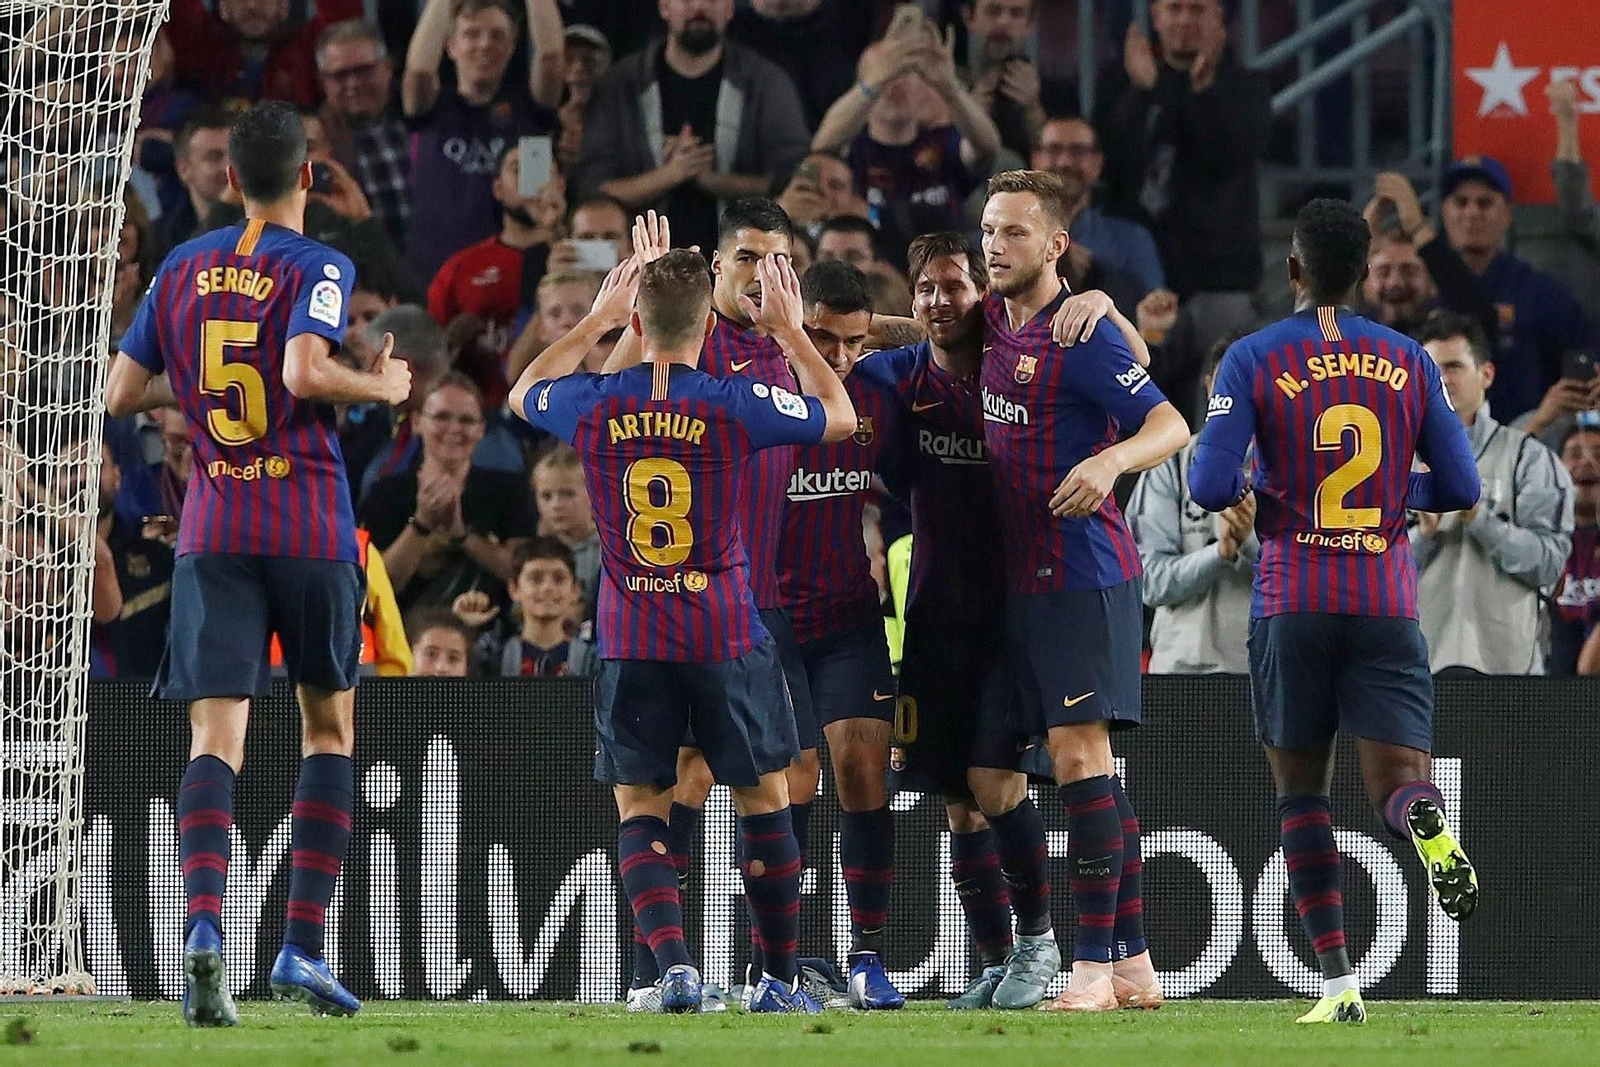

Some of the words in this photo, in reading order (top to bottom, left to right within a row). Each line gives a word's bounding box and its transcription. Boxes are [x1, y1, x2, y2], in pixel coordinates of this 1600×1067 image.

[197, 266, 274, 302] SERGIO
[199, 319, 268, 447] 5
[1275, 371, 1310, 400] N.
[1307, 353, 1409, 391] SEMEDO
[607, 411, 706, 445] ARTHUR
[208, 457, 263, 481] unicef
[1313, 403, 1383, 530] 2
[623, 457, 694, 568] 8
[1296, 531, 1362, 551] unicef
[625, 572, 682, 594] unicef
